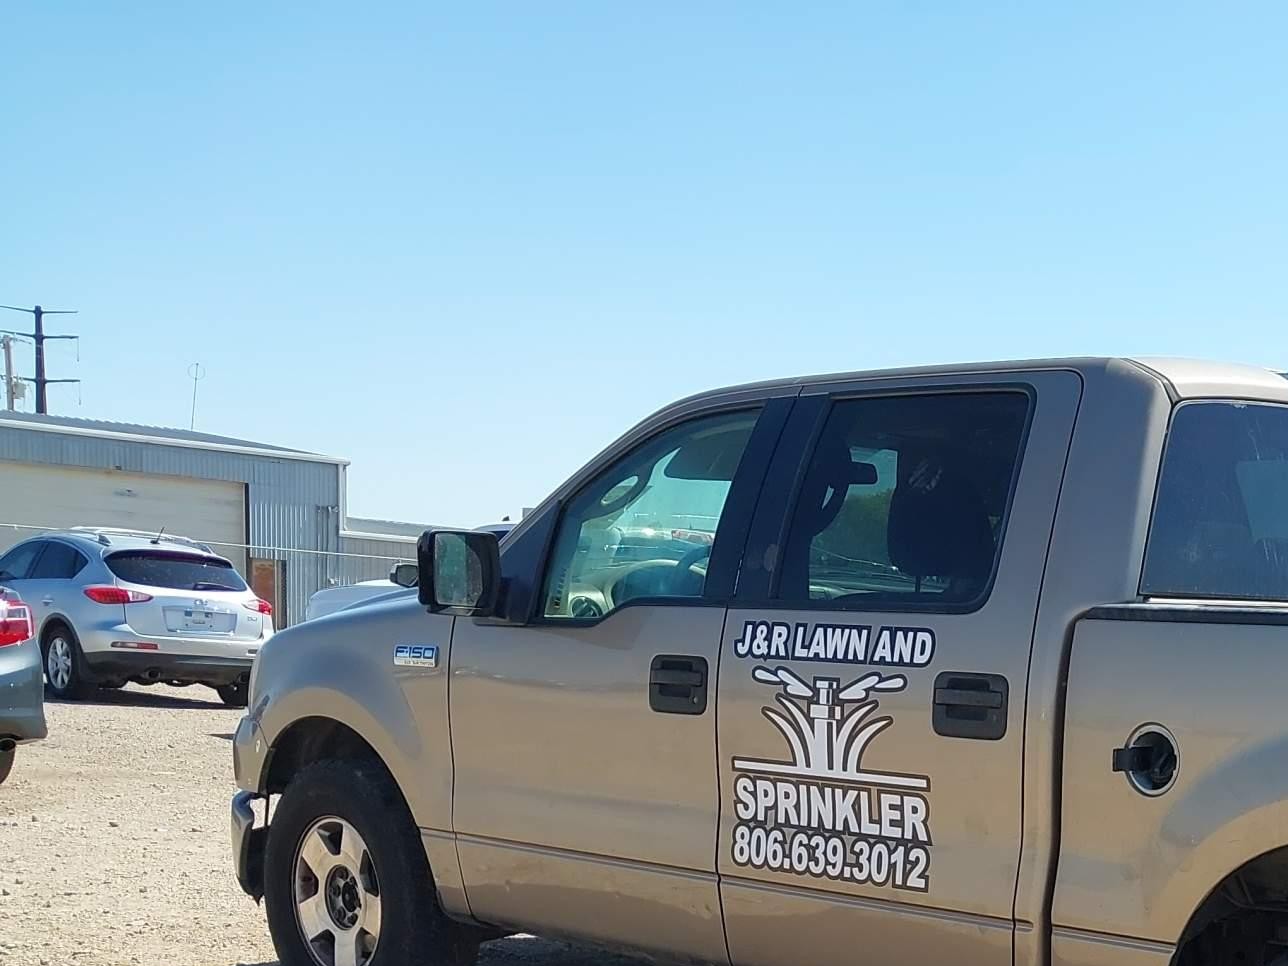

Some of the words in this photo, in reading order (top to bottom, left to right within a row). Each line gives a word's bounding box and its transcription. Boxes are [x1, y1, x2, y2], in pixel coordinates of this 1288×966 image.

[736, 624, 787, 657] J&R
[795, 627, 868, 660] LAWN
[873, 631, 932, 663] AND
[736, 778, 928, 841] SPRINKLER
[734, 827, 926, 888] 806.639.3012
